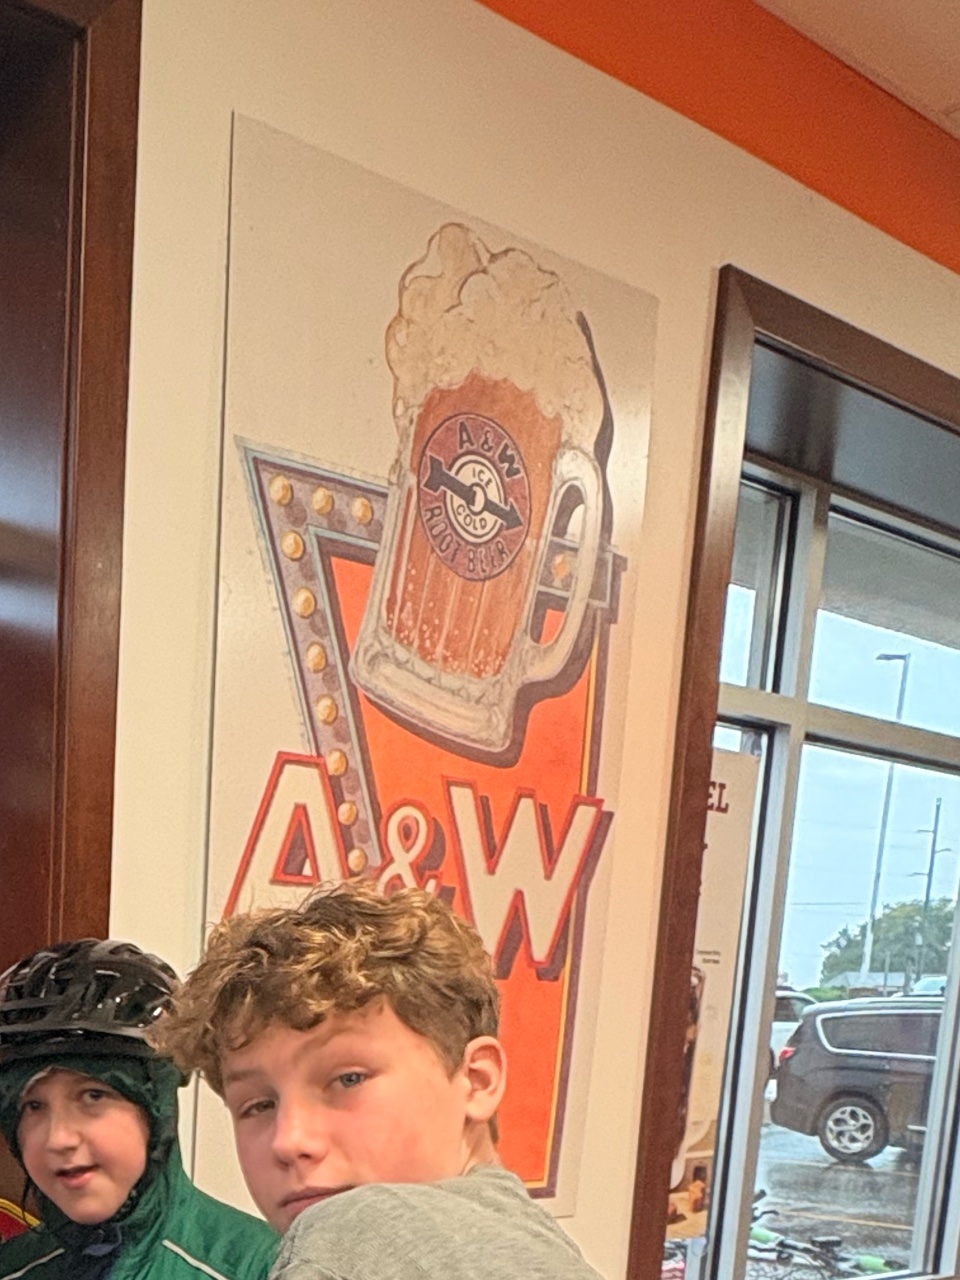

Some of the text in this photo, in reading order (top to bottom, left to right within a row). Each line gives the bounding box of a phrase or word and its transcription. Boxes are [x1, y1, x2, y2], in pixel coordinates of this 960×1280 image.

[459, 421, 521, 478] A&W
[472, 467, 494, 488] ICE
[424, 504, 465, 563] ROOT
[456, 503, 487, 531] COLD
[467, 540, 508, 573] BEER
[224, 750, 604, 968] A&W
